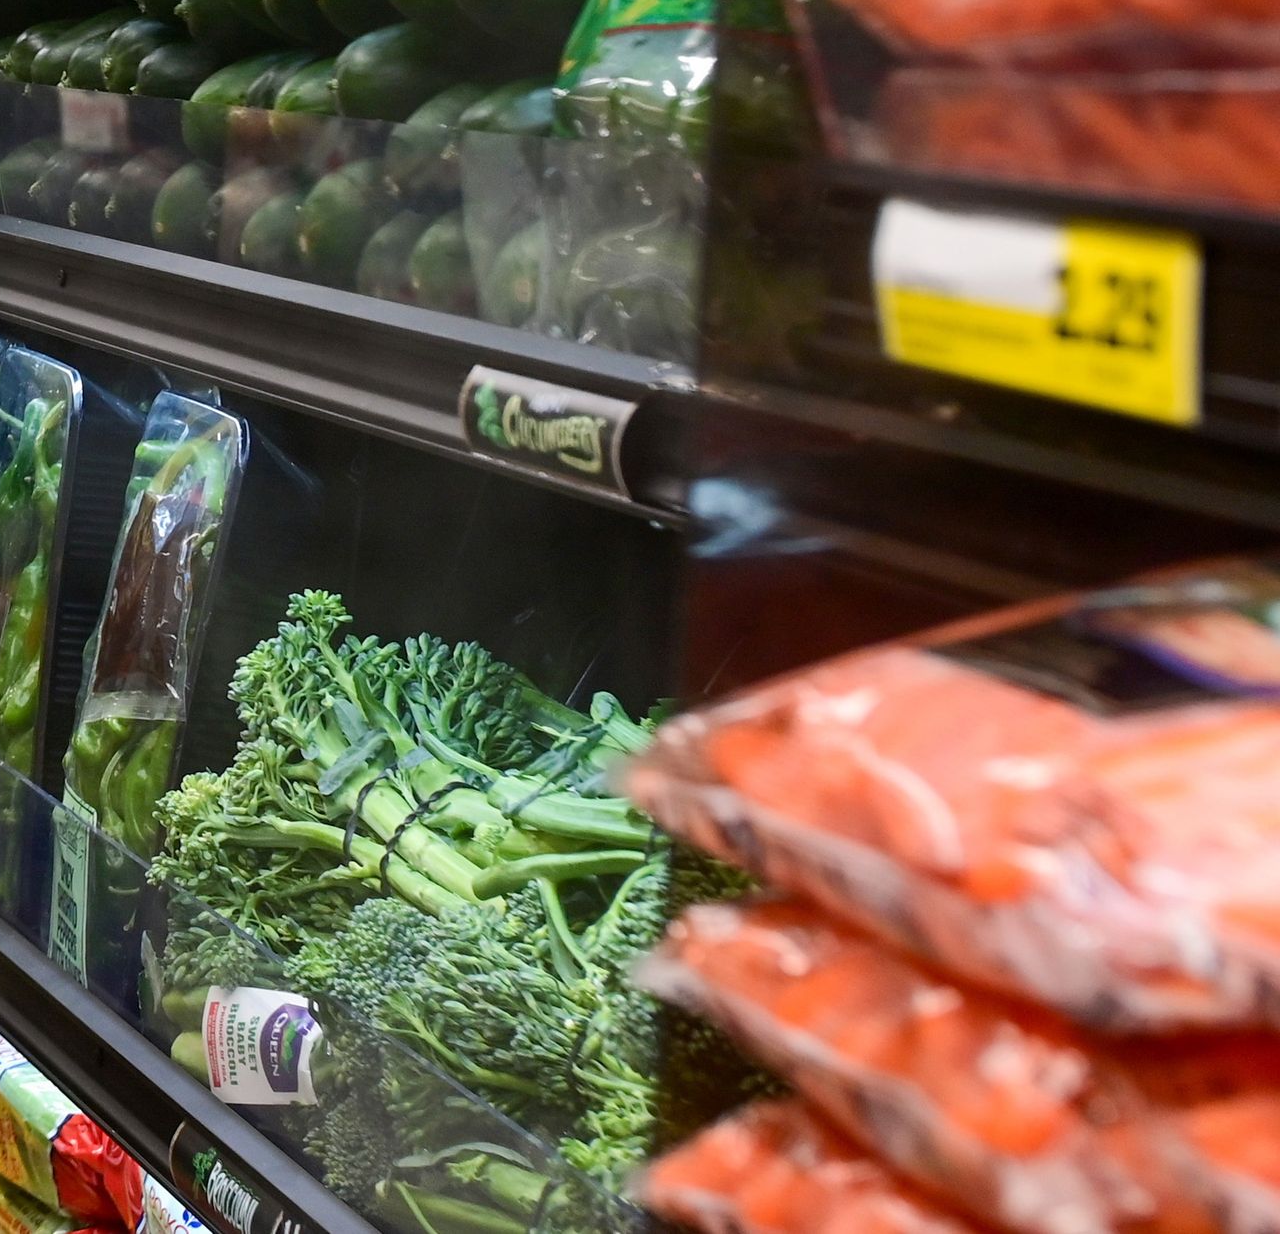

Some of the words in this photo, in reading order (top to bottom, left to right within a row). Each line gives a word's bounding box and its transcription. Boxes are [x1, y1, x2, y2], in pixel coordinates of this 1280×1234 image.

[225, 1003, 240, 1086] BROCCOLI
[236, 1021, 246, 1067] BABY
[247, 1015, 260, 1074] SWEET
[269, 1012, 289, 1077] QUEEN
